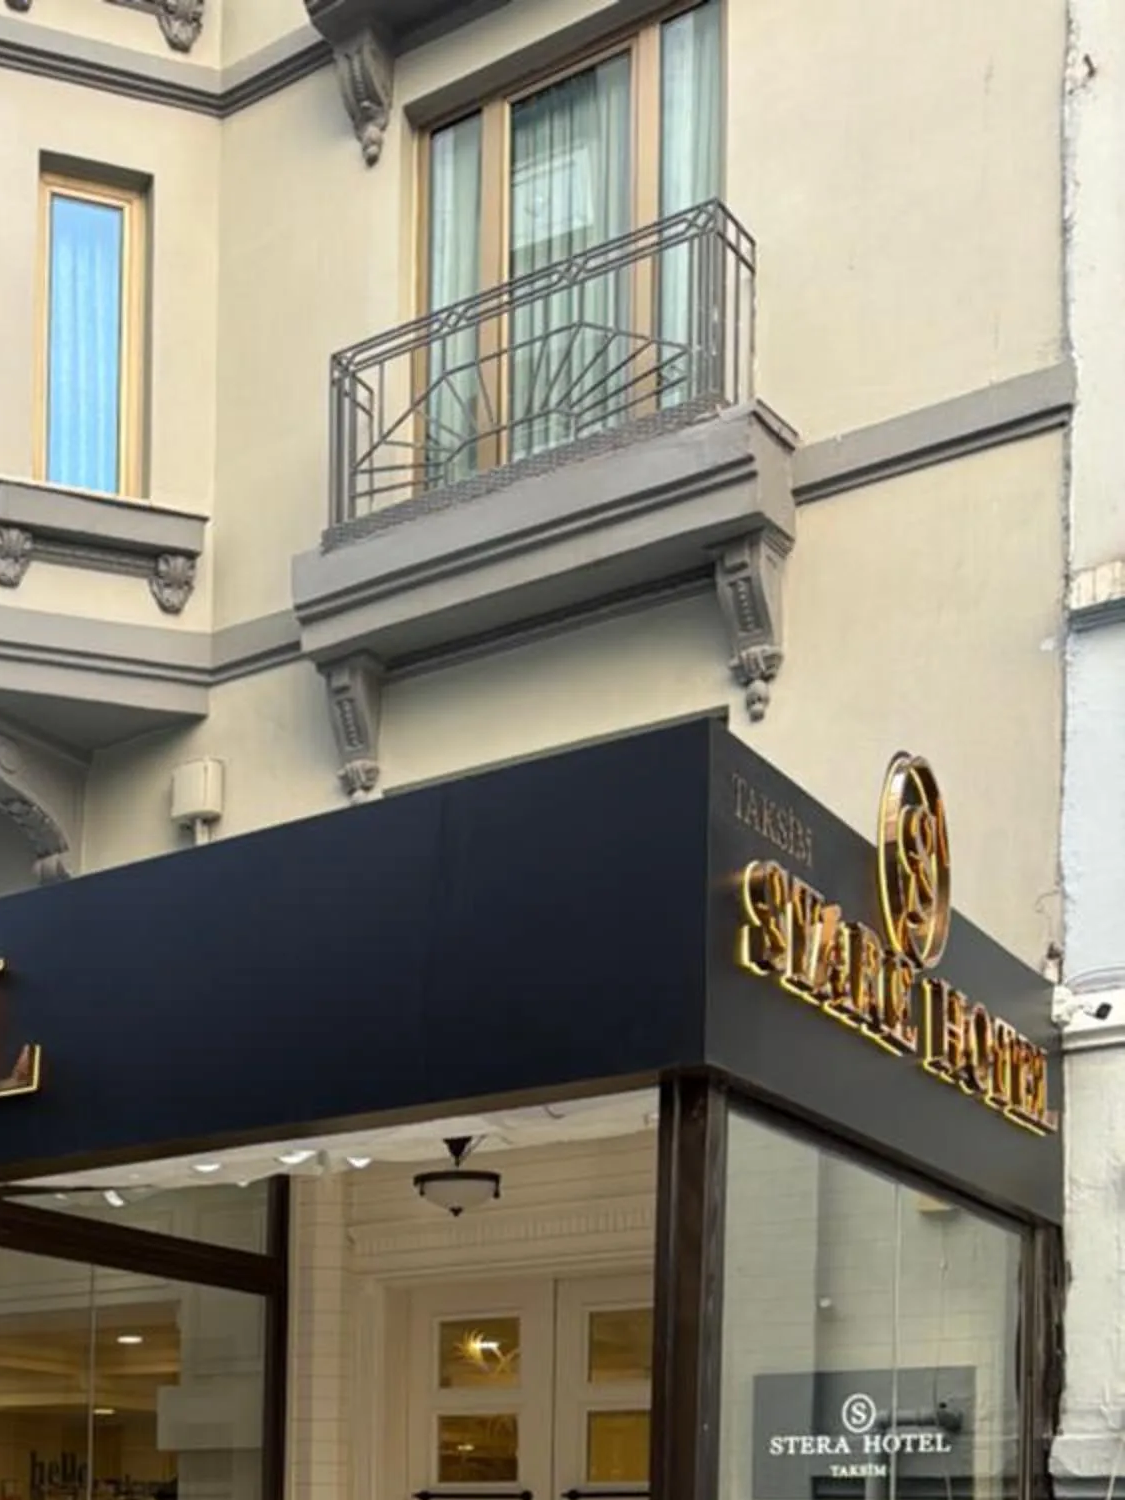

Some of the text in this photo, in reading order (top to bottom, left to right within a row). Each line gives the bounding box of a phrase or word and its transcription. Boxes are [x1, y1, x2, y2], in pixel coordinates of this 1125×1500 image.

[739, 859, 1059, 1136] STARE HOTEL
[850, 1401, 868, 1425] S
[769, 1432, 952, 1456] STERA HOTEL
